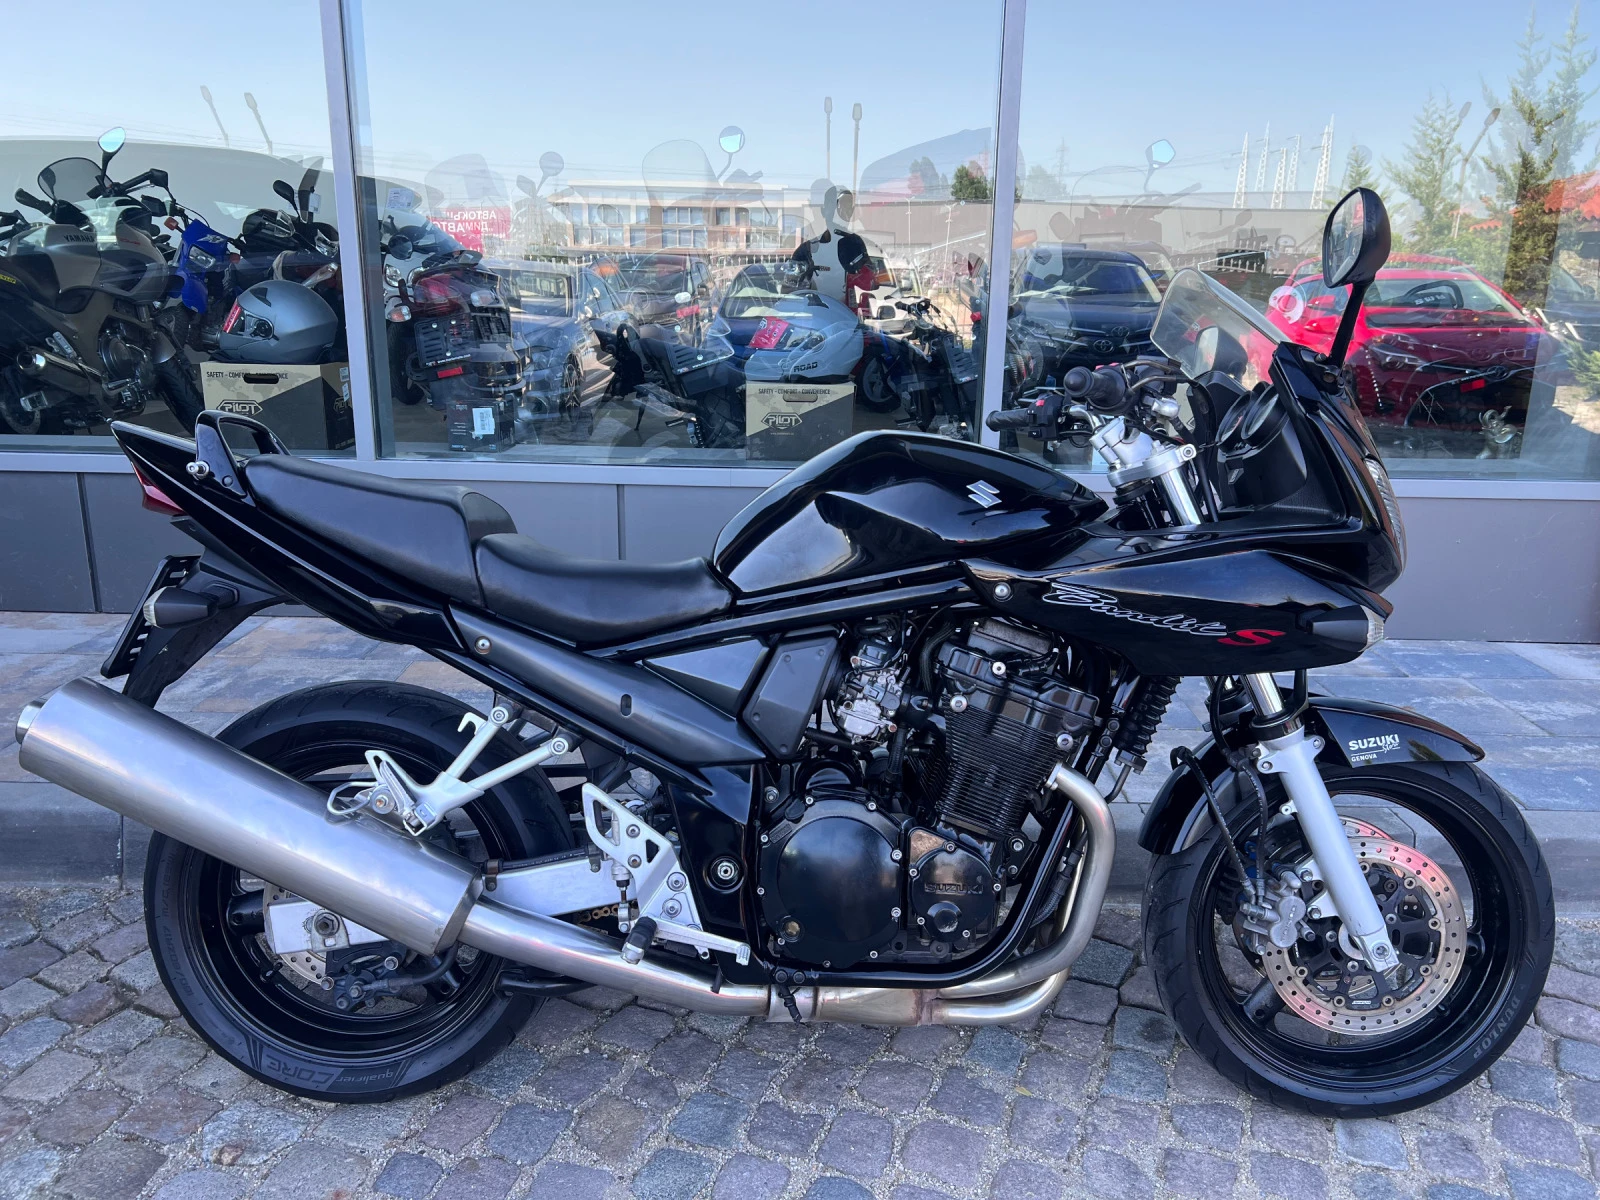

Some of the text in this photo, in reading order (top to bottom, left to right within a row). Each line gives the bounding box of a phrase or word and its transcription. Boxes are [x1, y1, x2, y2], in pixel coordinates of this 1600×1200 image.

[63, 234, 95, 243] YAMAHA
[793, 362, 818, 373] ROAD
[1042, 582, 1287, 646] Bandit S
[1348, 733, 1400, 751] SUZUKI
[1351, 753, 1378, 762] GENOVA
[924, 883, 984, 896] SUZUKI
[1473, 995, 1521, 1059] DUNLOP
[266, 1054, 394, 1085] qualifier CORE
